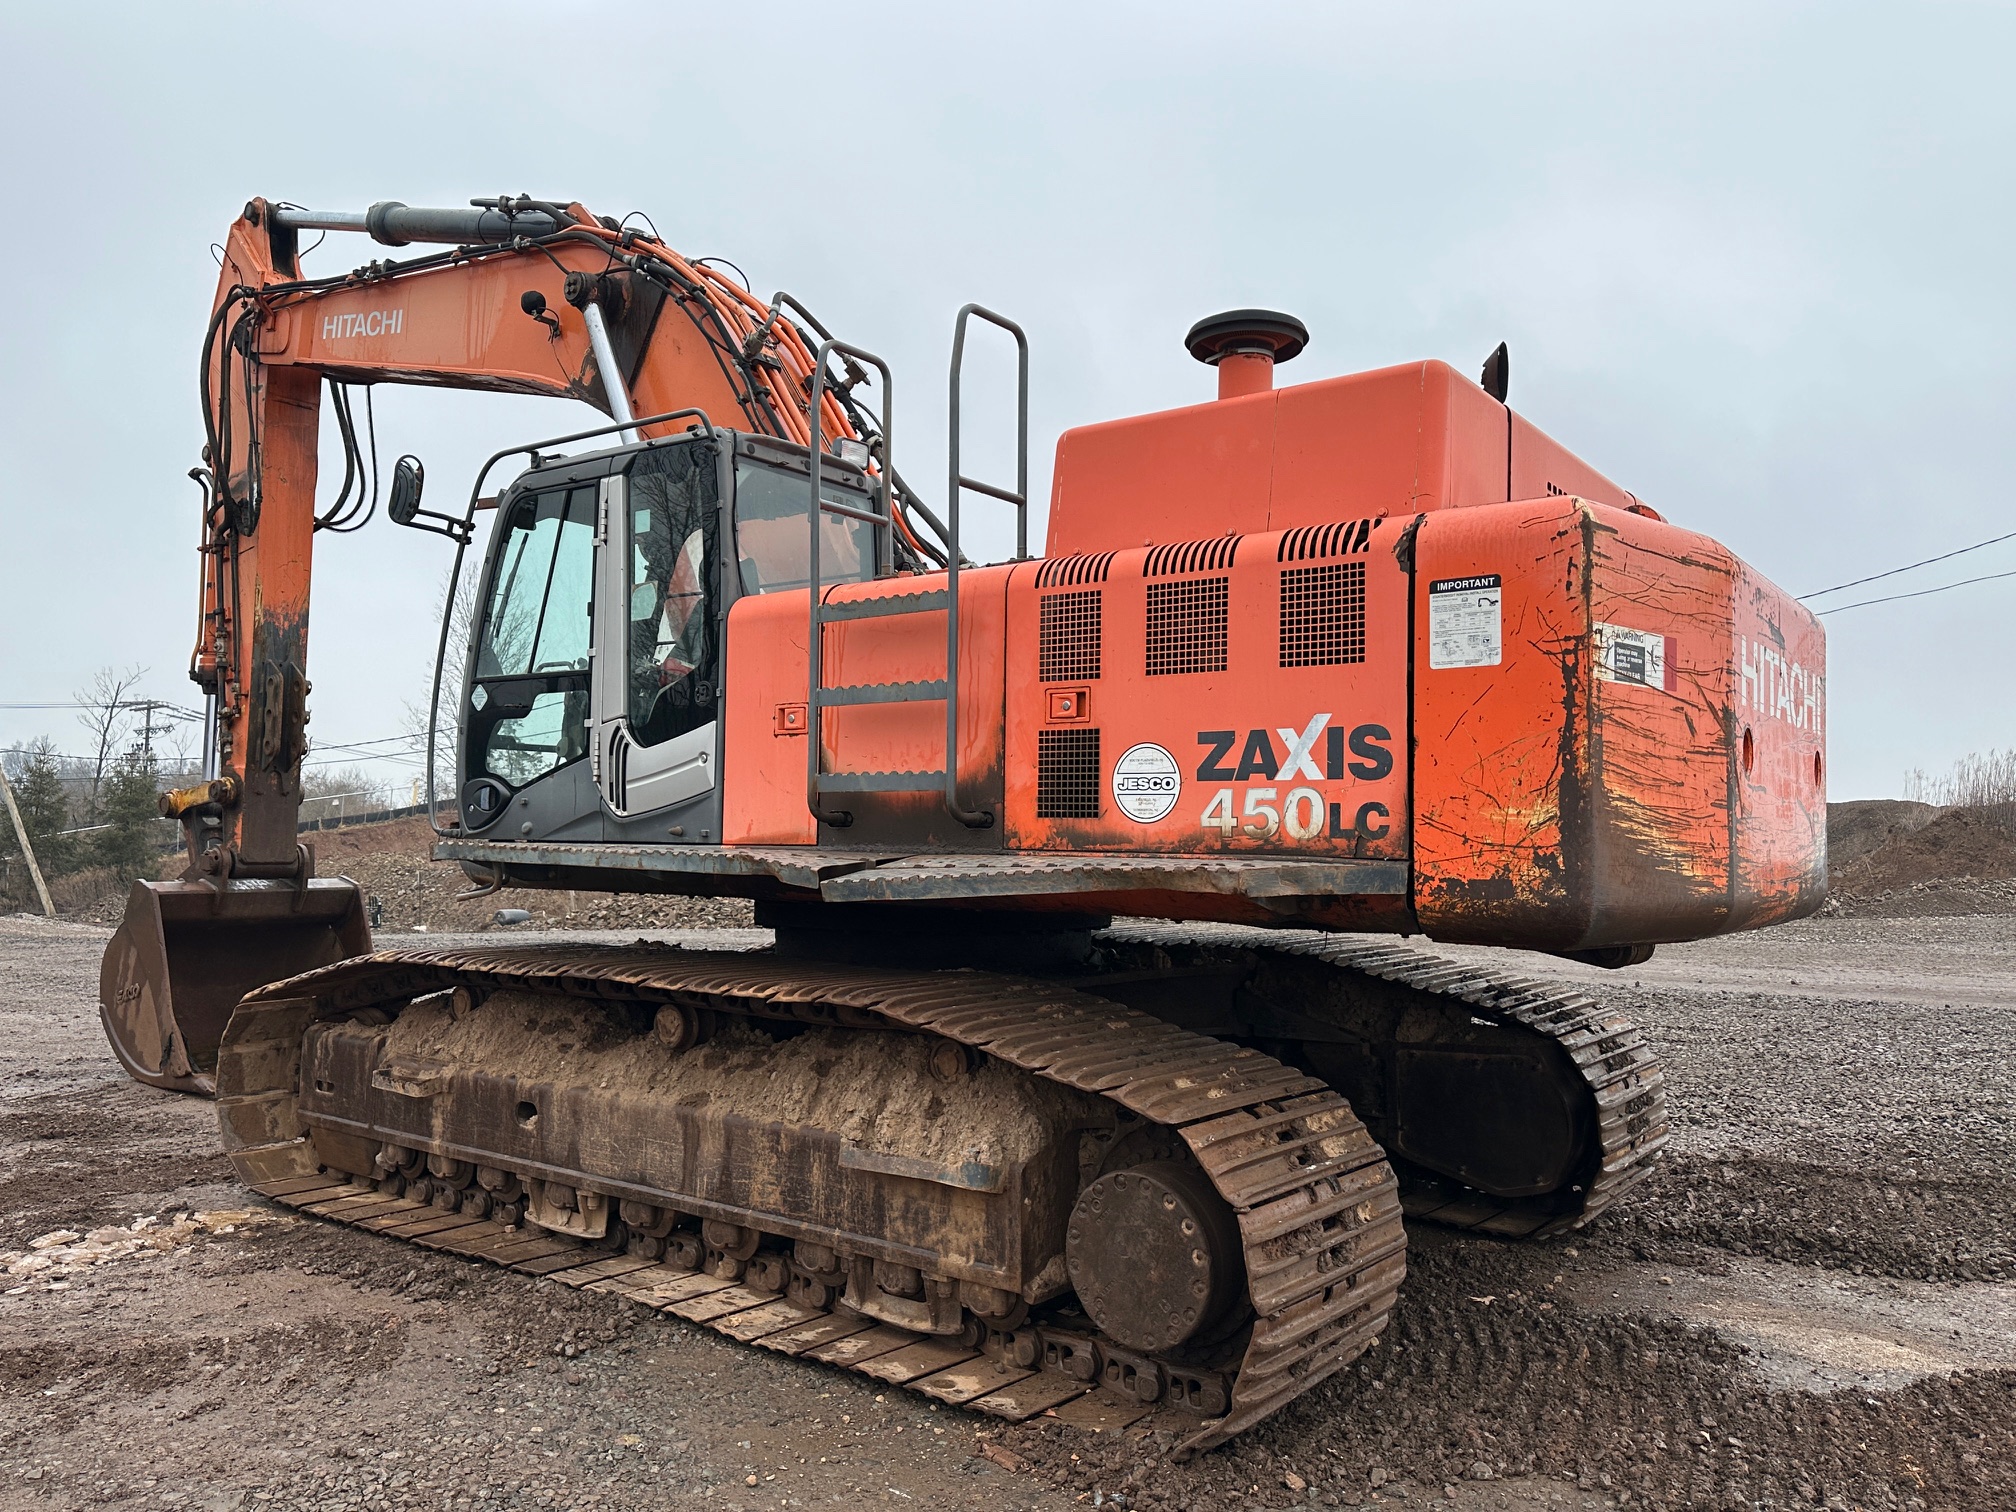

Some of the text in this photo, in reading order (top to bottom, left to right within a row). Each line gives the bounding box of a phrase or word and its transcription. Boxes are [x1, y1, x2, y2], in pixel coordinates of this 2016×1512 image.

[322, 309, 403, 340] HITACHI
[1437, 577, 1495, 591] IMPORTANT
[1620, 630, 1644, 643] WARNING
[1741, 634, 1821, 735] HITACHI
[1197, 713, 1394, 782] ZAXIS
[1117, 776, 1176, 791] JESCO
